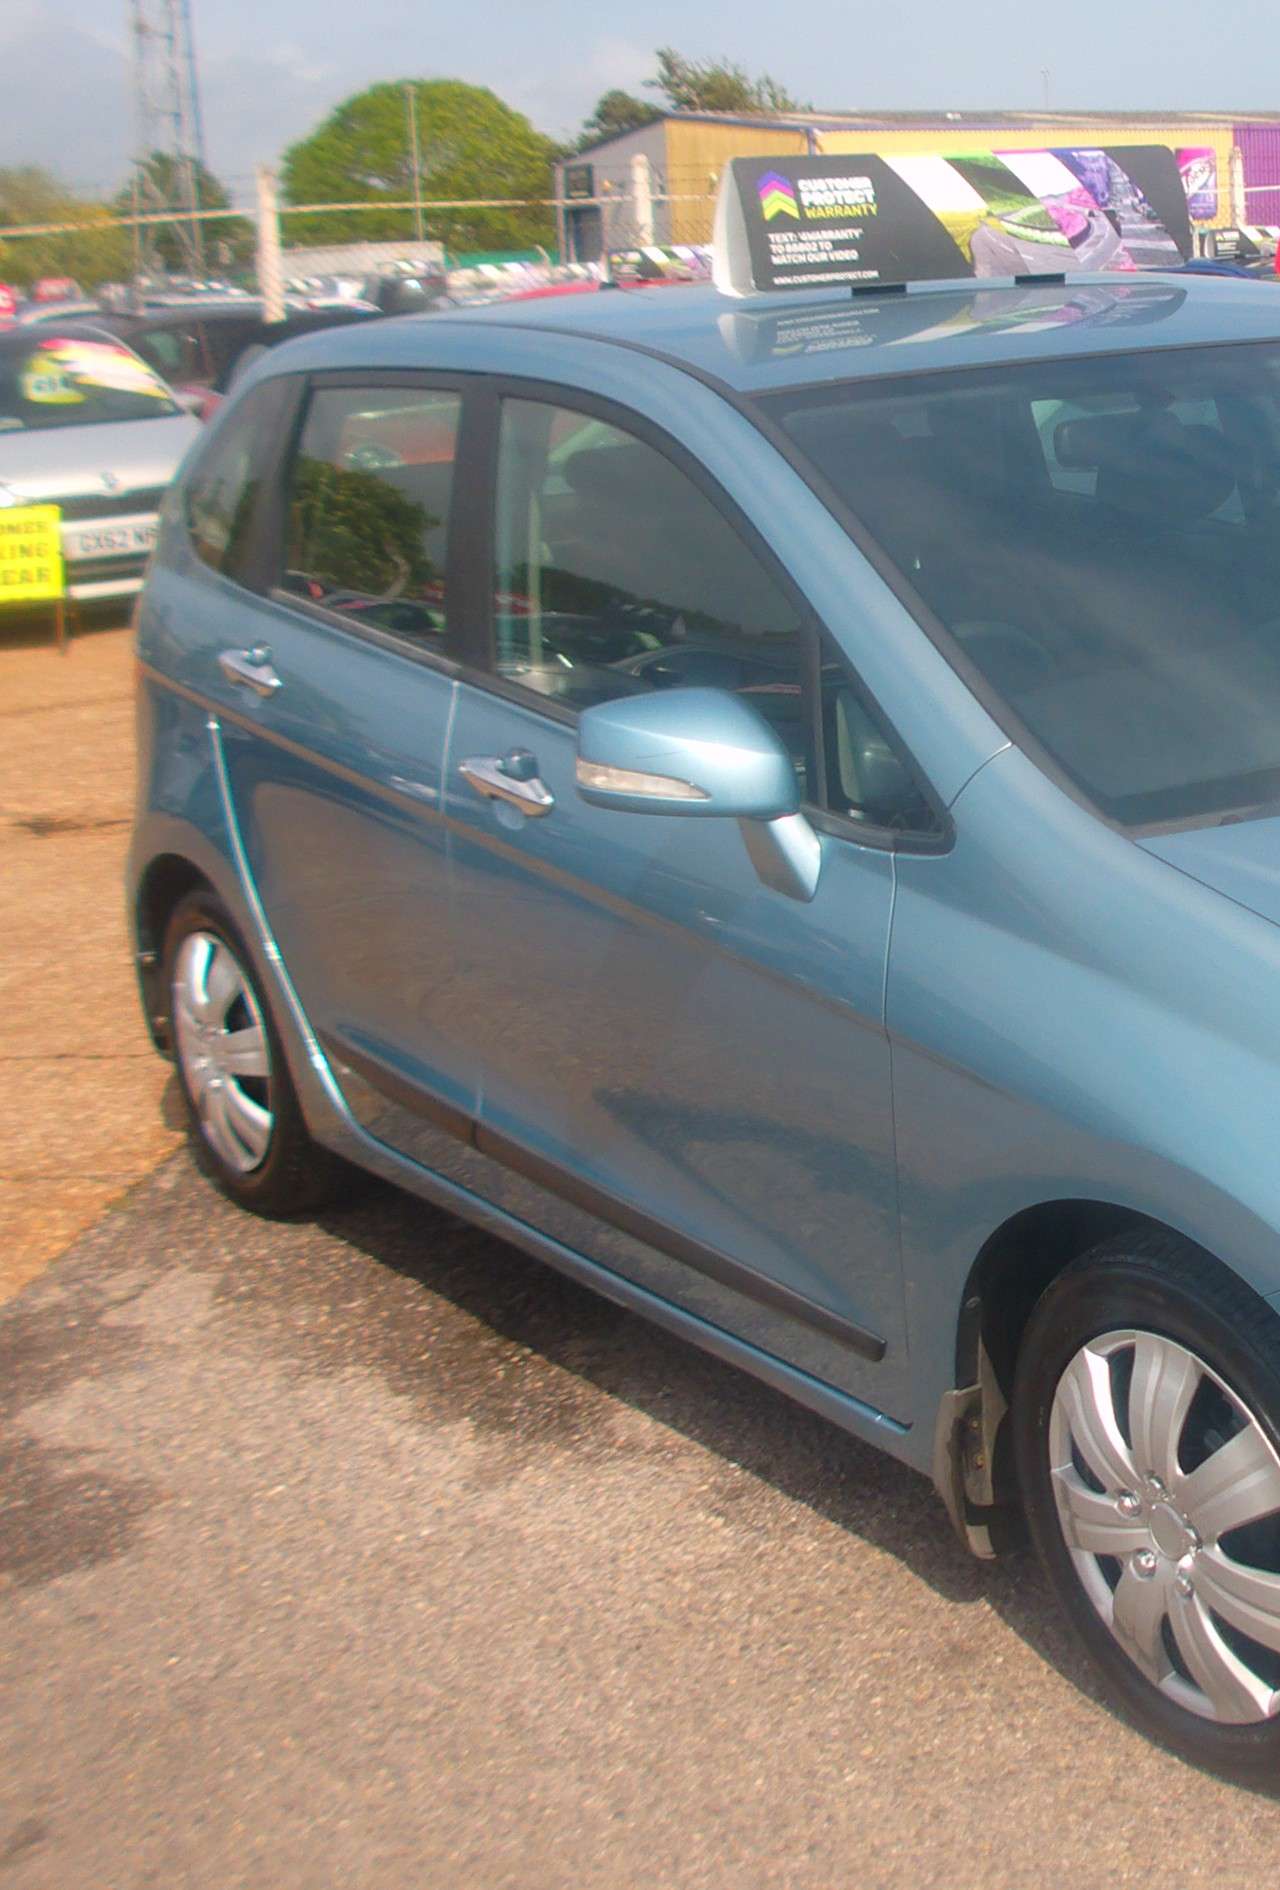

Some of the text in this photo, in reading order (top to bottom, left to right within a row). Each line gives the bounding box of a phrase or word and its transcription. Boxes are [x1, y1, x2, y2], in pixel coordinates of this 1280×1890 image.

[798, 176, 873, 192] CUSTOMER
[800, 188, 876, 206] PROTECT
[804, 203, 877, 219] WARRANTY
